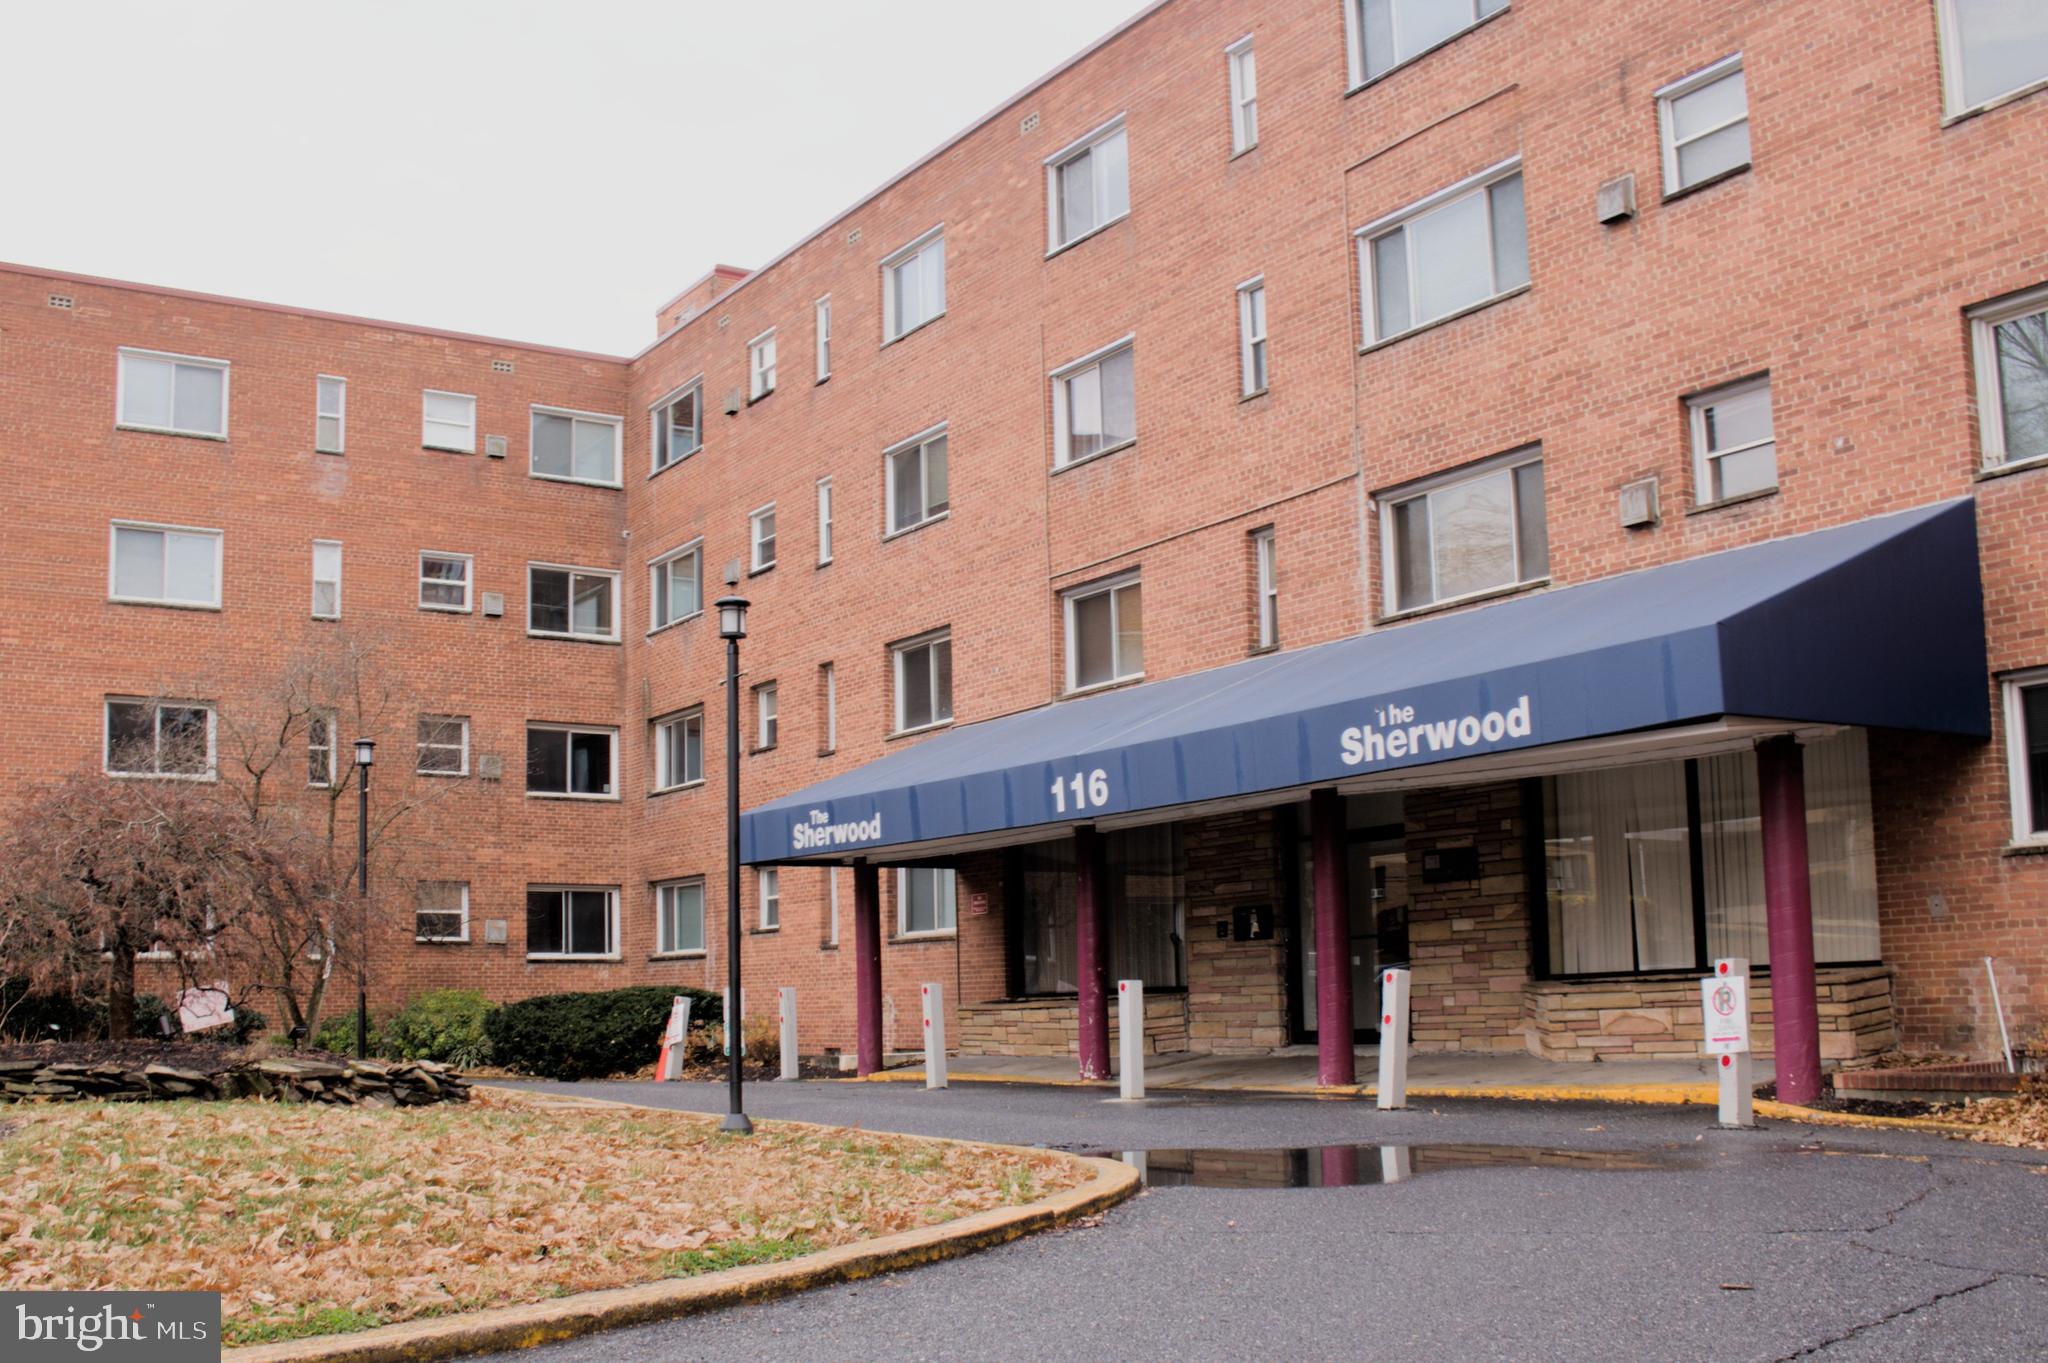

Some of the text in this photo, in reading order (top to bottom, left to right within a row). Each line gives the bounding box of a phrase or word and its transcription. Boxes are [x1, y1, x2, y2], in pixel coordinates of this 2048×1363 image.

[1340, 695, 1532, 766] Sherwood
[1050, 768, 1110, 813] 116
[792, 812, 882, 850] Sherwood
[809, 809, 830, 826] The
